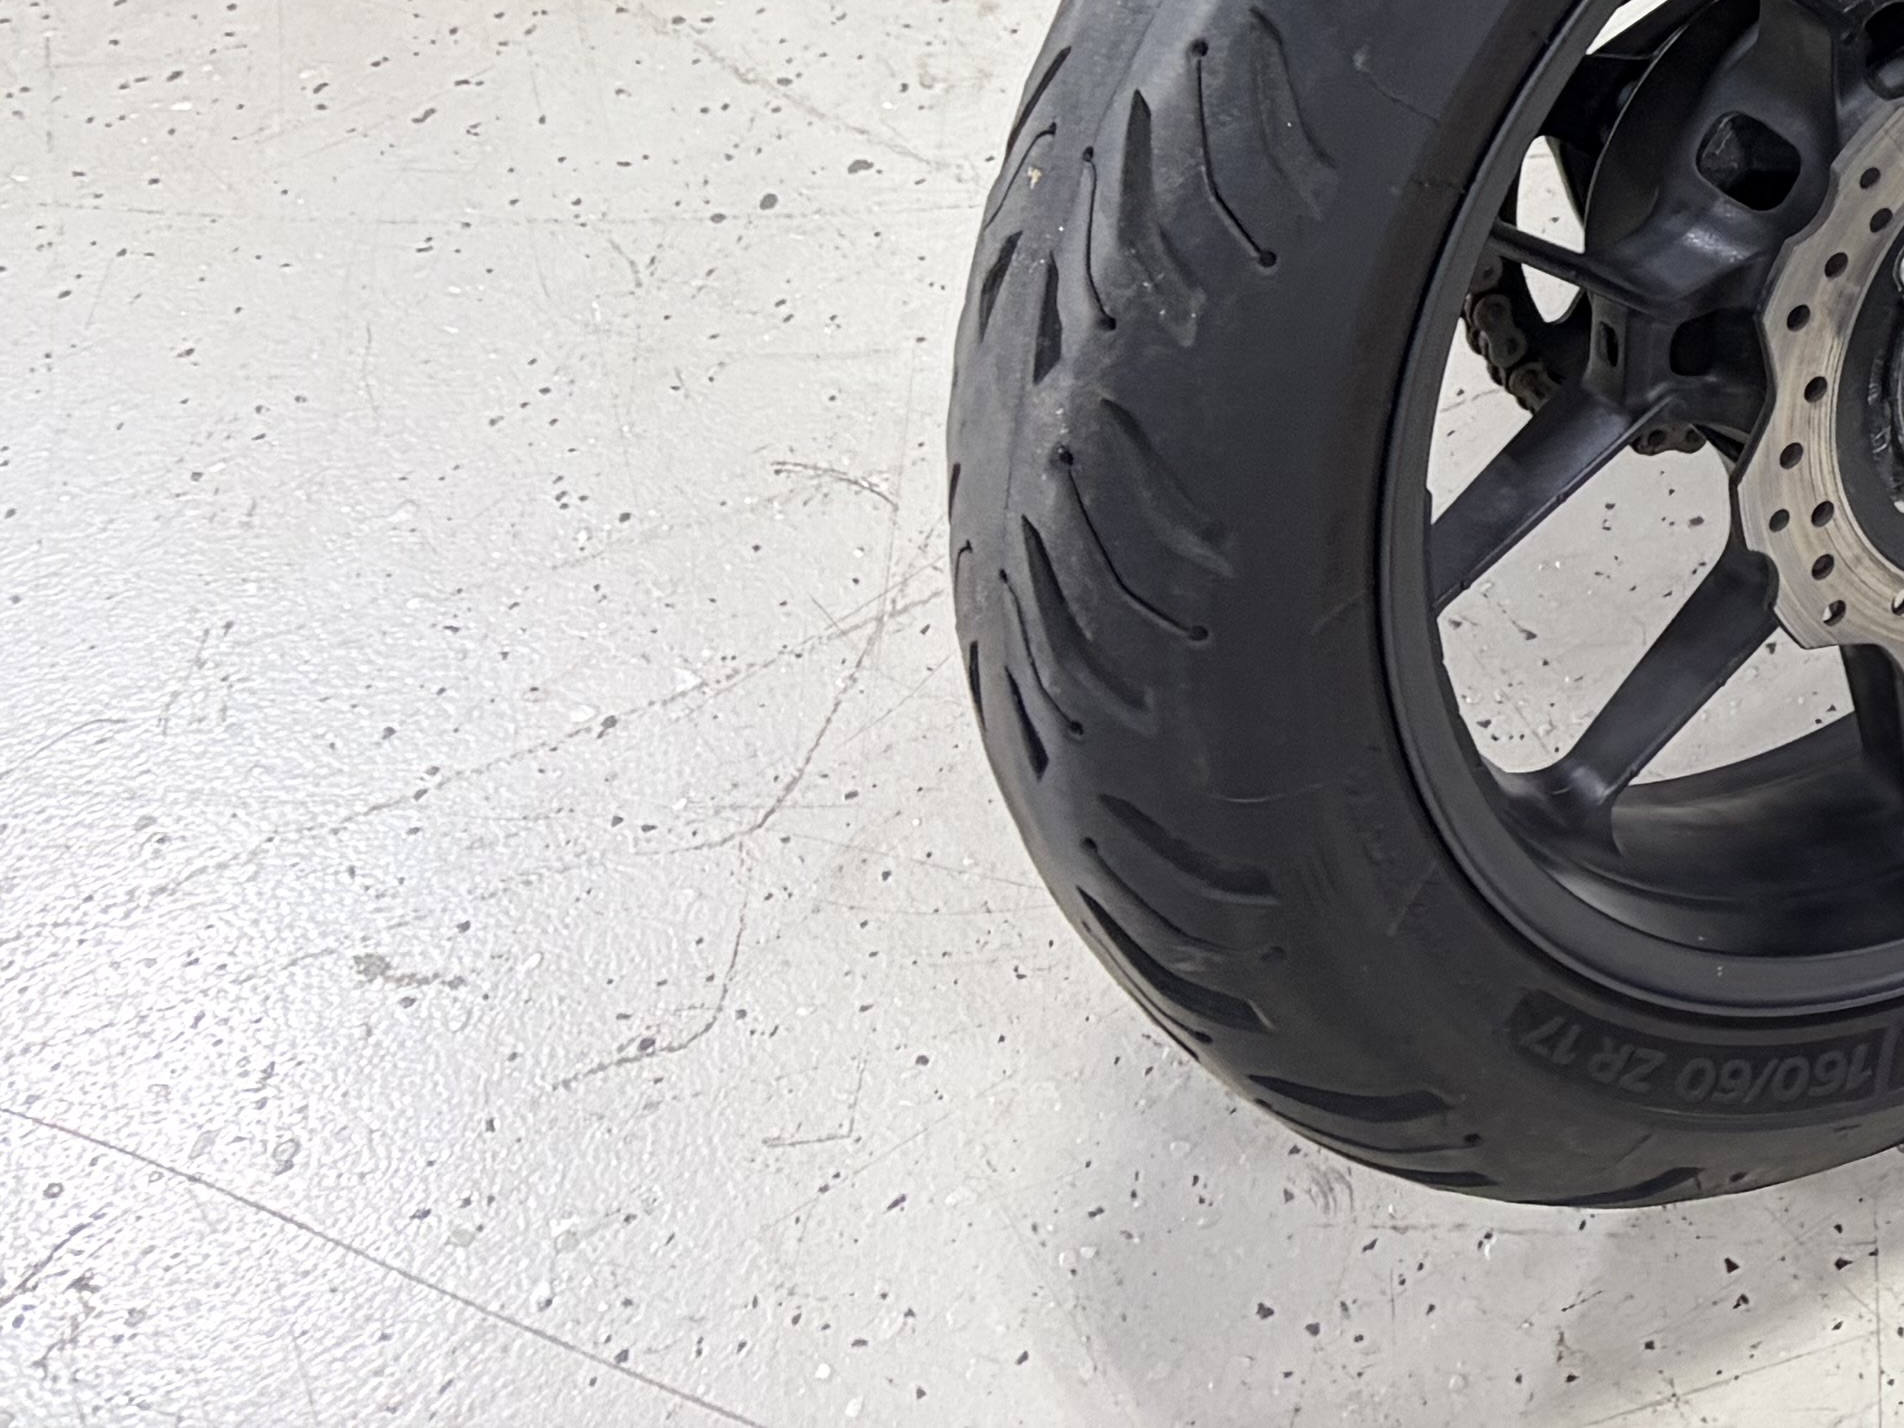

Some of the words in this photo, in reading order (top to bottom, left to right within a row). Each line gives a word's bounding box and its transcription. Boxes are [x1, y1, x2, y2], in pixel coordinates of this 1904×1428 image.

[1518, 1016, 1580, 1065] 17
[1586, 1037, 1666, 1094] ZR
[1675, 1044, 1873, 1104] 160/60
